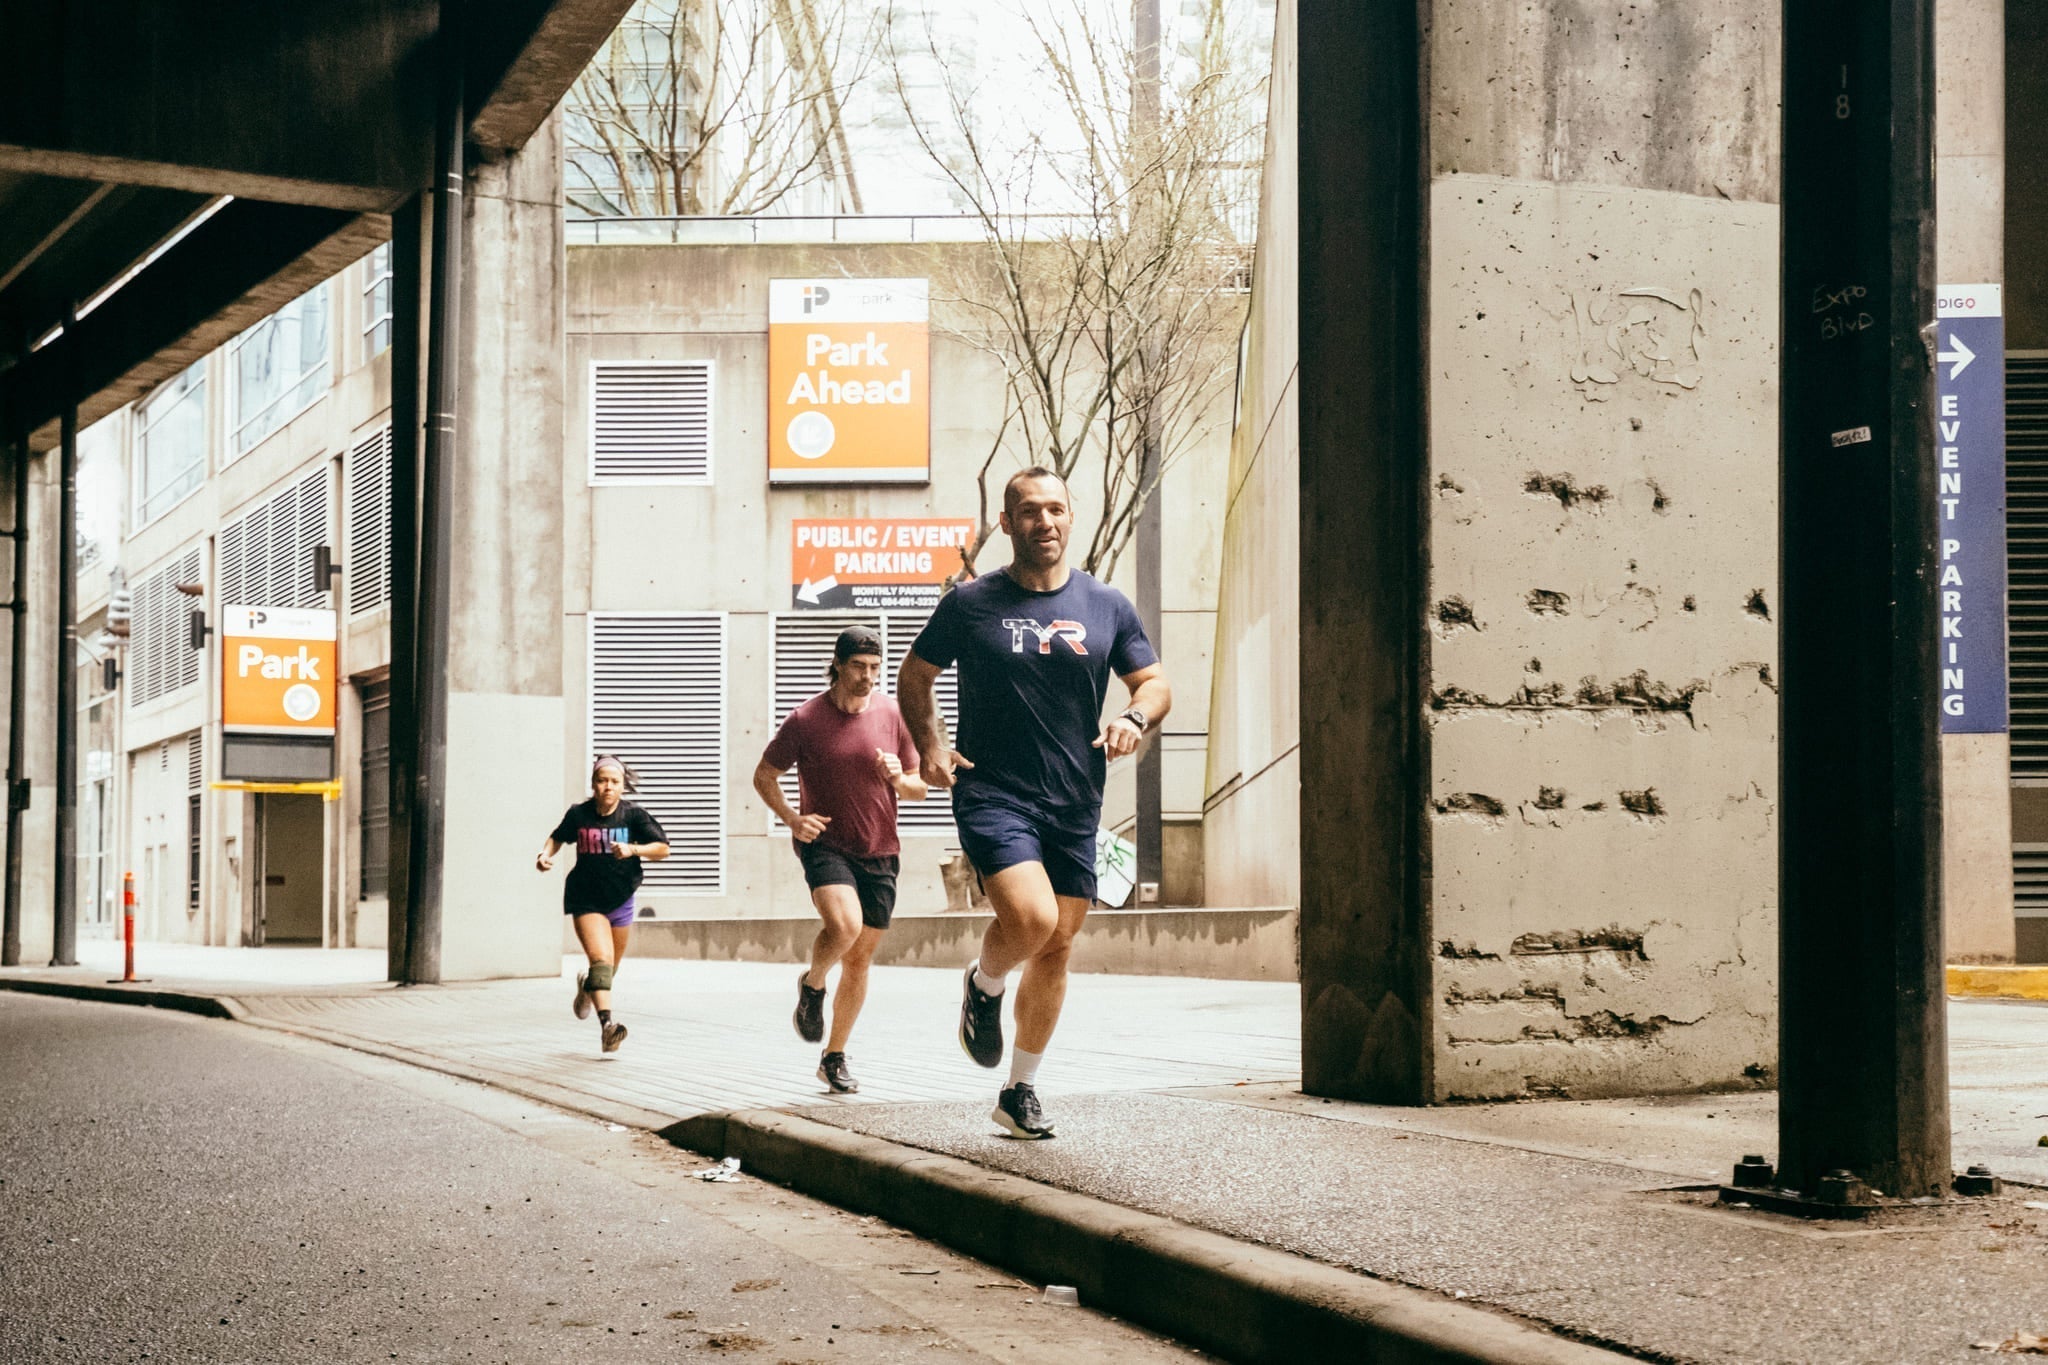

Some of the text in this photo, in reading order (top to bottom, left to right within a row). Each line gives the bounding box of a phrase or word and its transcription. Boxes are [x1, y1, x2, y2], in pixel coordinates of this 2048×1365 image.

[806, 331, 889, 367] Park
[786, 369, 911, 405] Ahead
[797, 526, 878, 548] PUBLIC
[897, 526, 970, 548] EVENT
[834, 552, 933, 574] PARKING
[1939, 395, 1965, 716] EVENT PARKING
[852, 586, 941, 596] MONTHLY PARKING
[855, 597, 880, 607] CALL
[1002, 619, 1089, 655] TYR
[238, 645, 321, 681] Park
